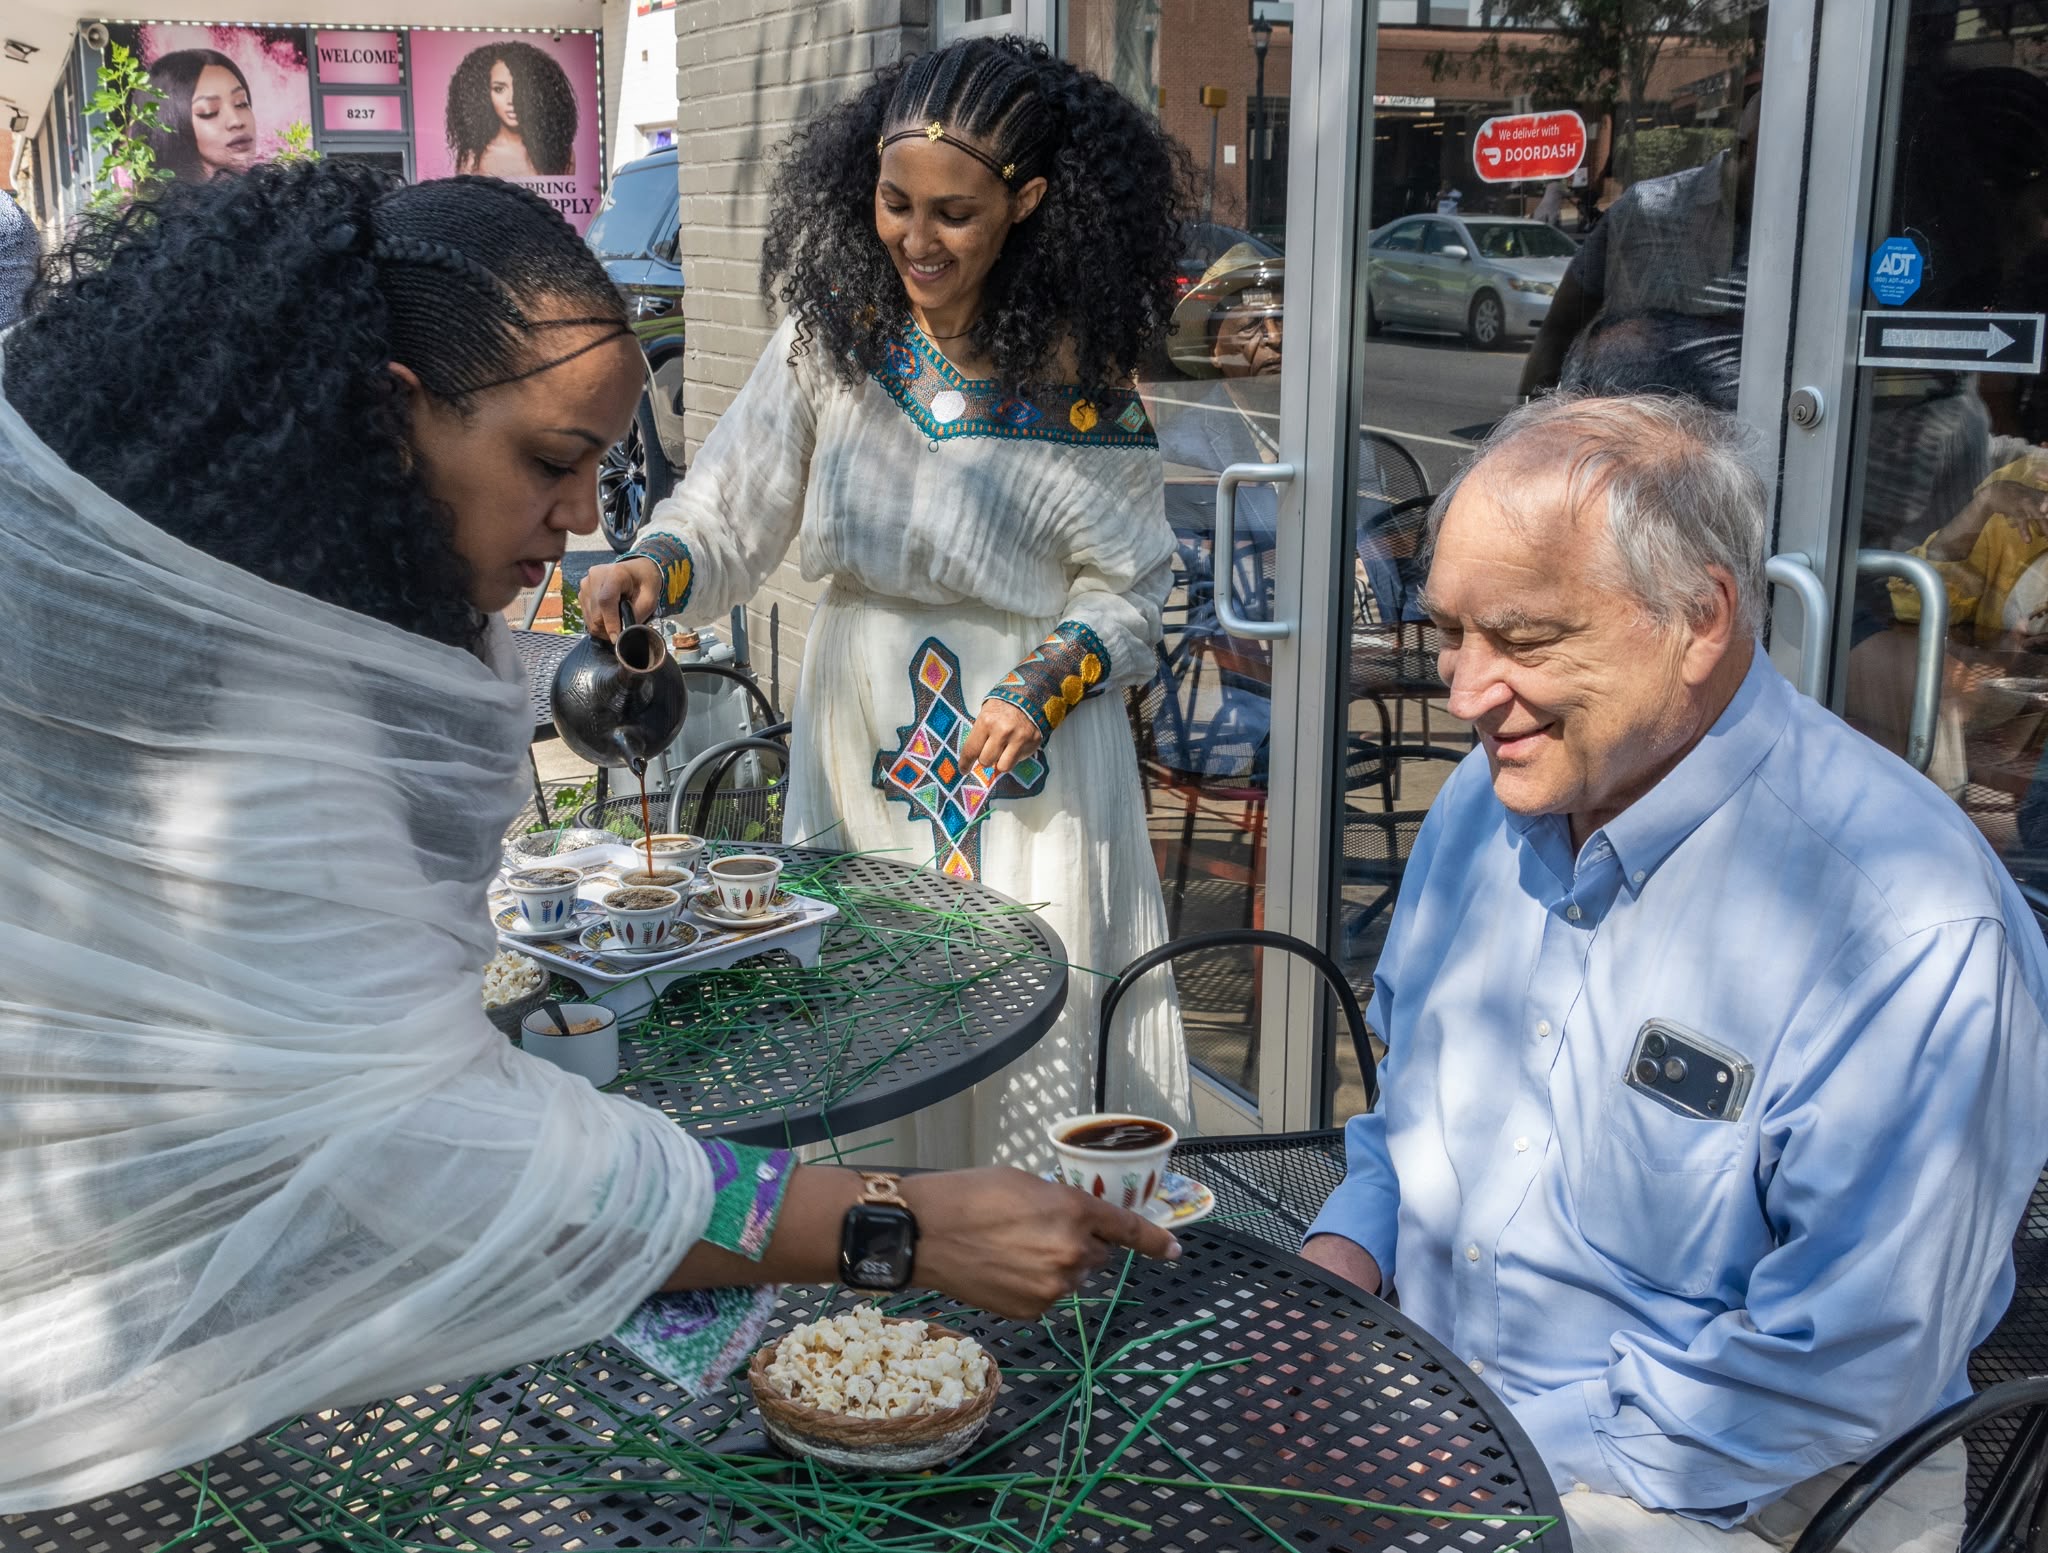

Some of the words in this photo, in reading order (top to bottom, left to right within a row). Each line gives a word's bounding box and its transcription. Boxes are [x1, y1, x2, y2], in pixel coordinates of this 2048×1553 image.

[320, 48, 398, 64] WELCOME
[347, 109, 375, 119] 8237
[1499, 129, 1511, 140] We
[1512, 127, 1539, 140] deliver
[1541, 124, 1560, 137] with
[1505, 143, 1576, 162] DOORDASH
[517, 181, 577, 194] PRING
[1876, 252, 1916, 276] ADT
